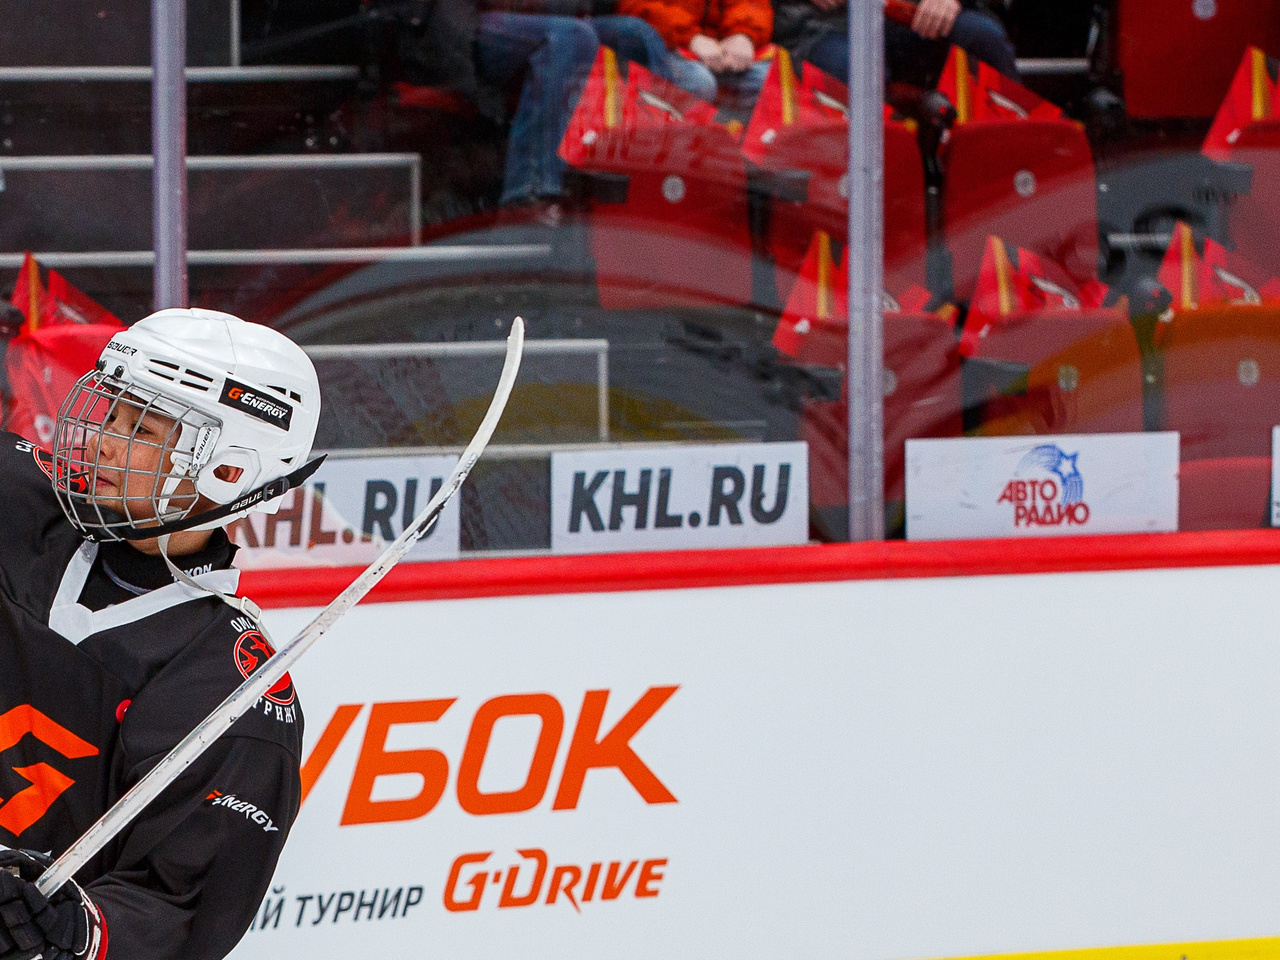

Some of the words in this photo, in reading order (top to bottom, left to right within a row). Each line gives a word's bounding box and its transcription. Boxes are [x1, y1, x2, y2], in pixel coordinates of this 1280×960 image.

[107, 341, 138, 357] BAUER
[195, 427, 213, 461] BAUER
[568, 463, 792, 533] KHL.RU
[998, 479, 1058, 503] АВТО
[1014, 502, 1090, 527] РАДИО
[230, 615, 260, 633] ОМС
[296, 886, 424, 926] ТУРНИР
